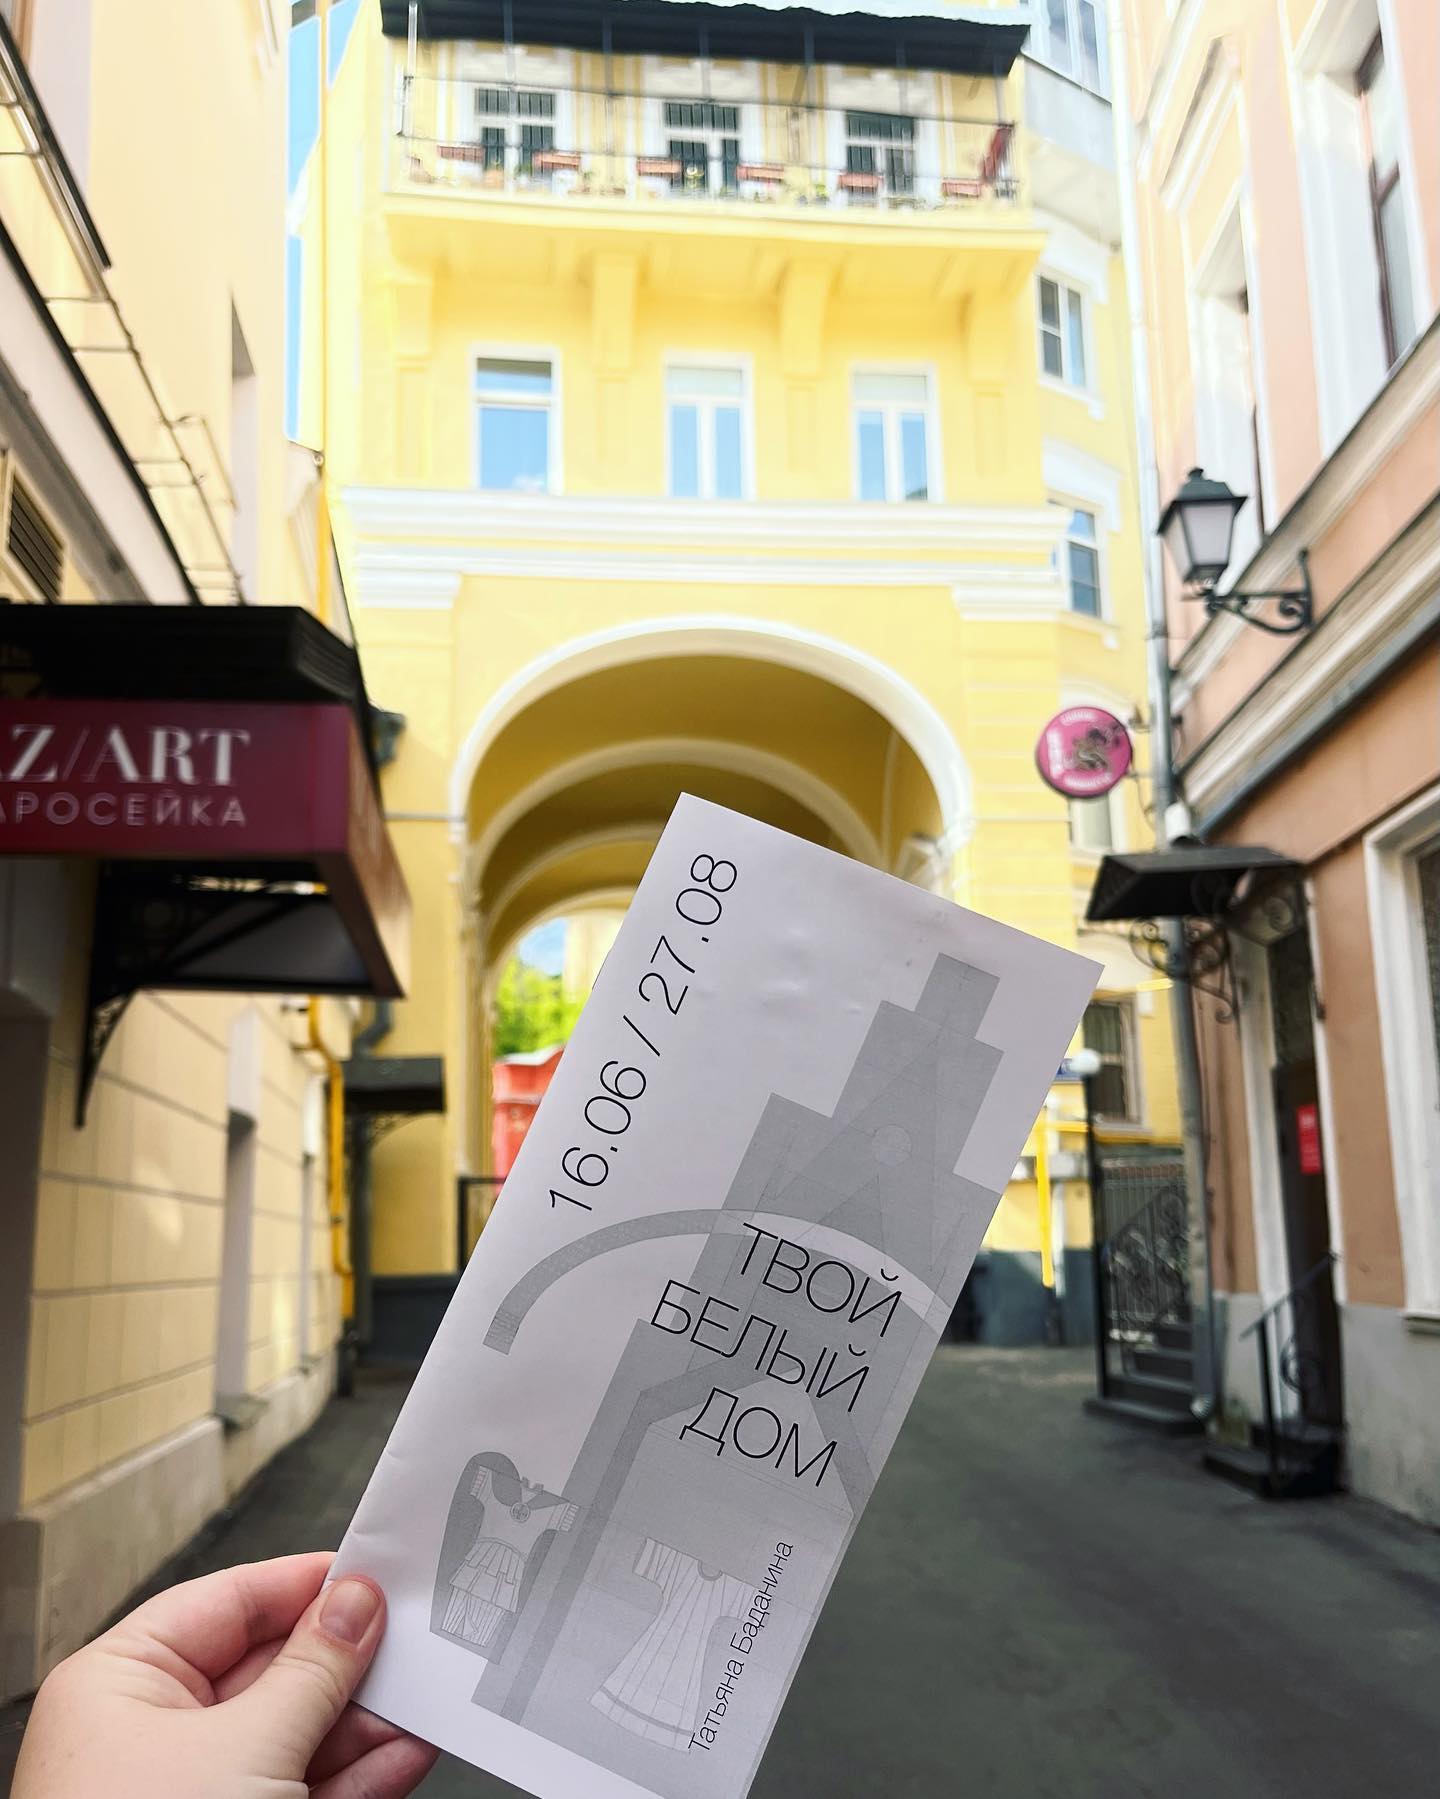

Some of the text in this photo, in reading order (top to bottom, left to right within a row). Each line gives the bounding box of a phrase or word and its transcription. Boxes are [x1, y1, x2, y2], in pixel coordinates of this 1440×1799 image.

[0, 723, 251, 786] Z/ART
[0, 789, 247, 828] РОСЕЙКА
[548, 853, 738, 1211] 16.06 / 27.08
[740, 1222, 903, 1338] ТВОЙ
[650, 1279, 870, 1413] БЕЛЫЙ
[678, 1386, 838, 1487] ДОМ
[687, 1540, 794, 1751] Татьяна Баданина
